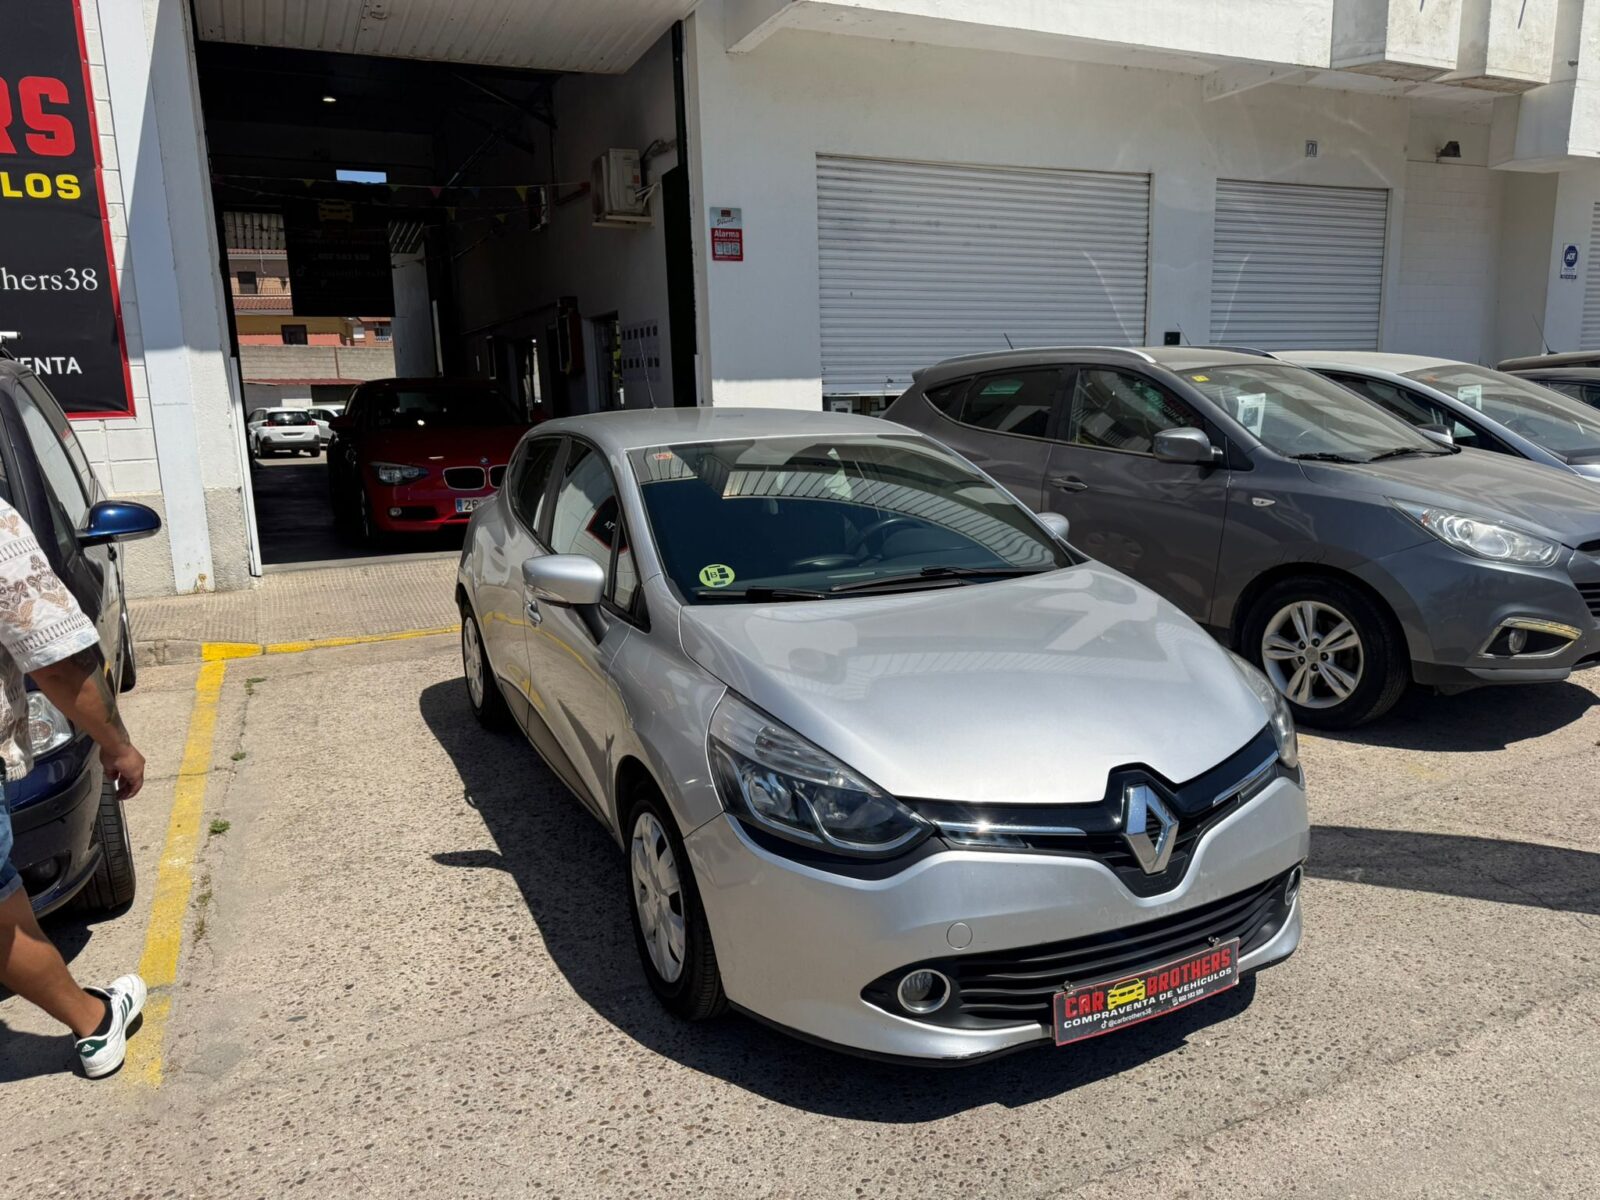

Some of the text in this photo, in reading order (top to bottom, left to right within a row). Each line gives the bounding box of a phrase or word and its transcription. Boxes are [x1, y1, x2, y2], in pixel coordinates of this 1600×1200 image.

[0, 172, 81, 199] LOS
[0, 267, 98, 291] hers38
[14, 356, 83, 375] ENTA
[1065, 948, 1232, 1018] CAR BROTHERS
[1063, 967, 1232, 1029] COMPRAVENTA DE VEHÍCULOS
